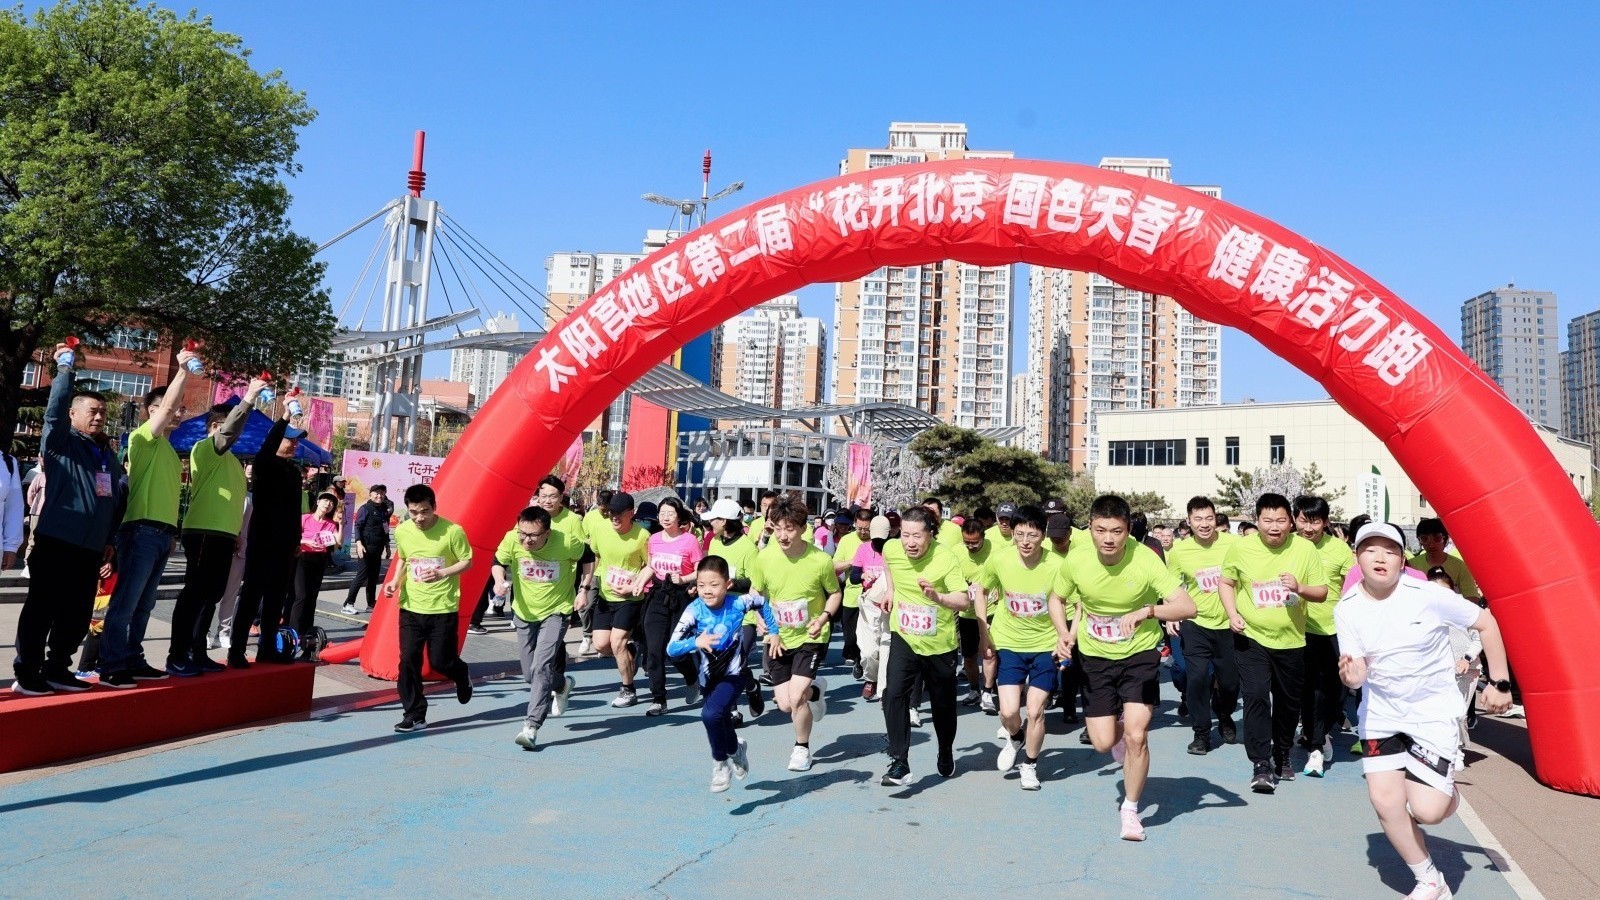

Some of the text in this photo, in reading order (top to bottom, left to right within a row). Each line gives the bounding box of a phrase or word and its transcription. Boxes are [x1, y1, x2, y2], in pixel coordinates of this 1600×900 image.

[526, 567, 554, 579] 207
[1258, 588, 1290, 602] 067
[1010, 600, 1043, 613] 013
[777, 609, 804, 623] 184
[901, 613, 932, 629] 053
